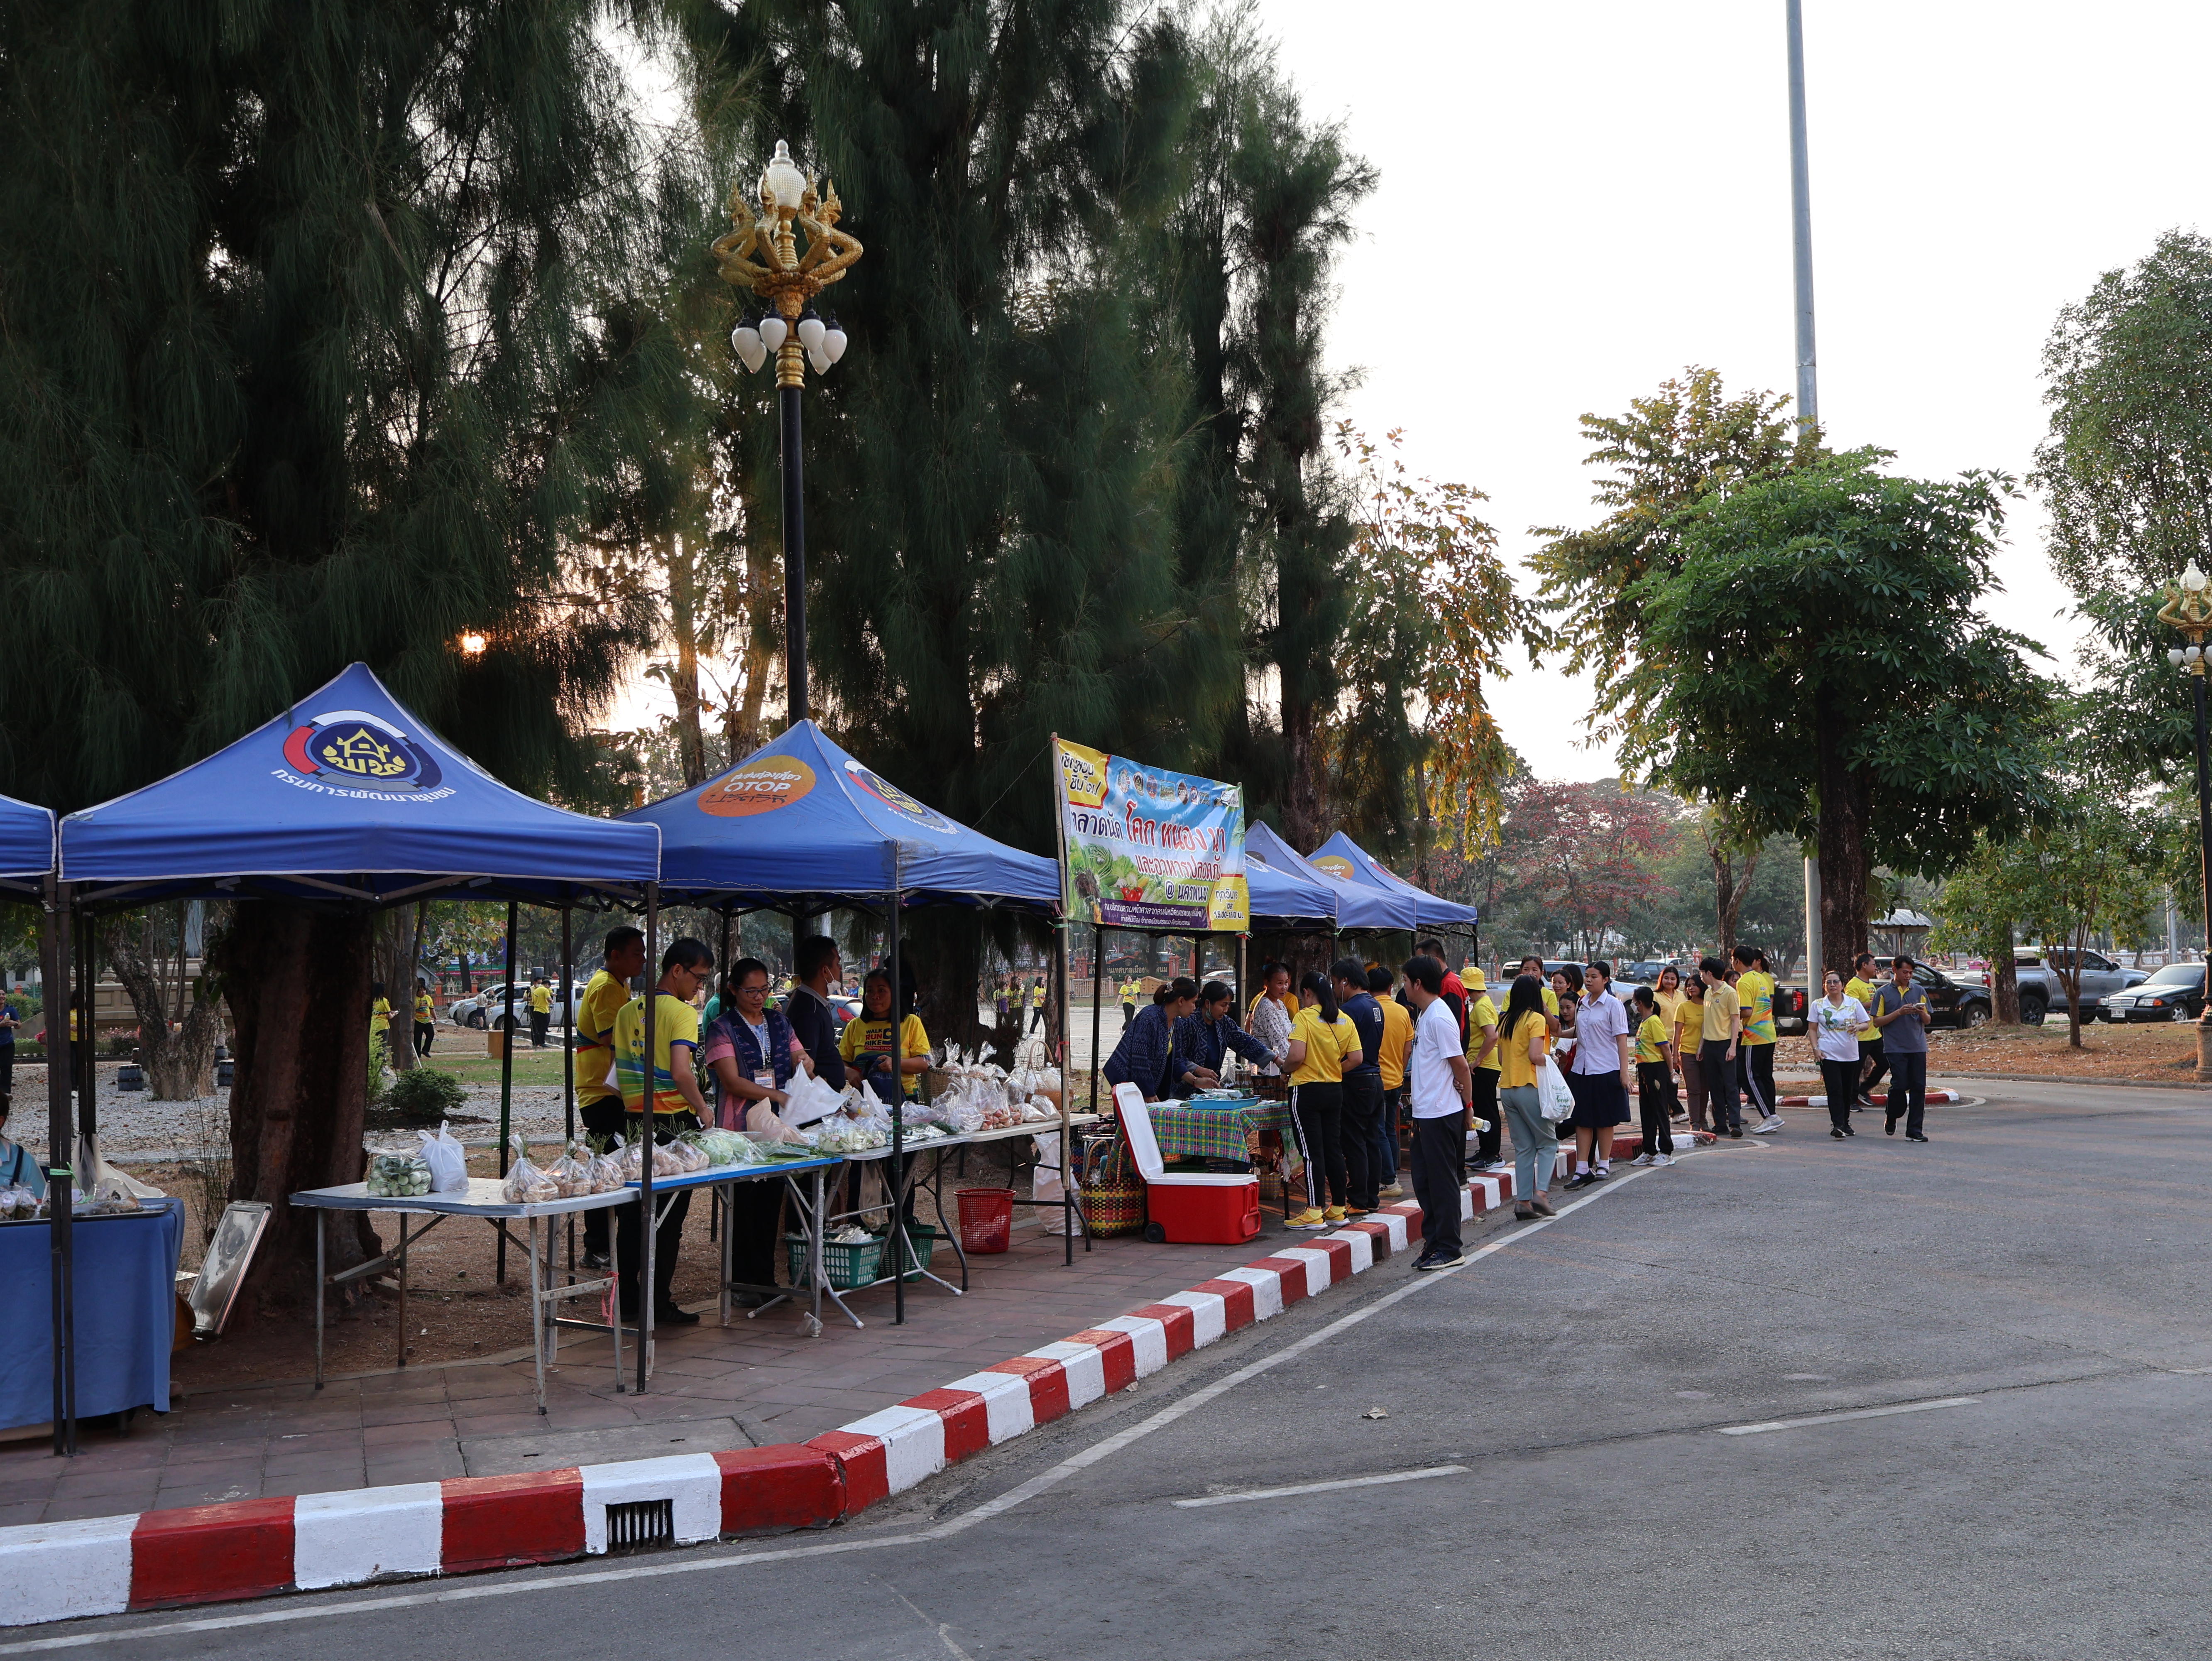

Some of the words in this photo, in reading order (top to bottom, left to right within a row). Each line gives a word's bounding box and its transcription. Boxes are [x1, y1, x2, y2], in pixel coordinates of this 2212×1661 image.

[730, 770, 802, 782] ชุมชนท่องเที่ยว
[1070, 774, 1084, 791] ชิม
[271, 769, 457, 802] กรมการพัฒนาชุมชน
[724, 781, 791, 792] OTOP
[1126, 800, 1155, 846] โคก
[1162, 823, 1208, 851] หนอง
[1208, 827, 1226, 853] นา
[1177, 884, 1208, 901] นครพนม
